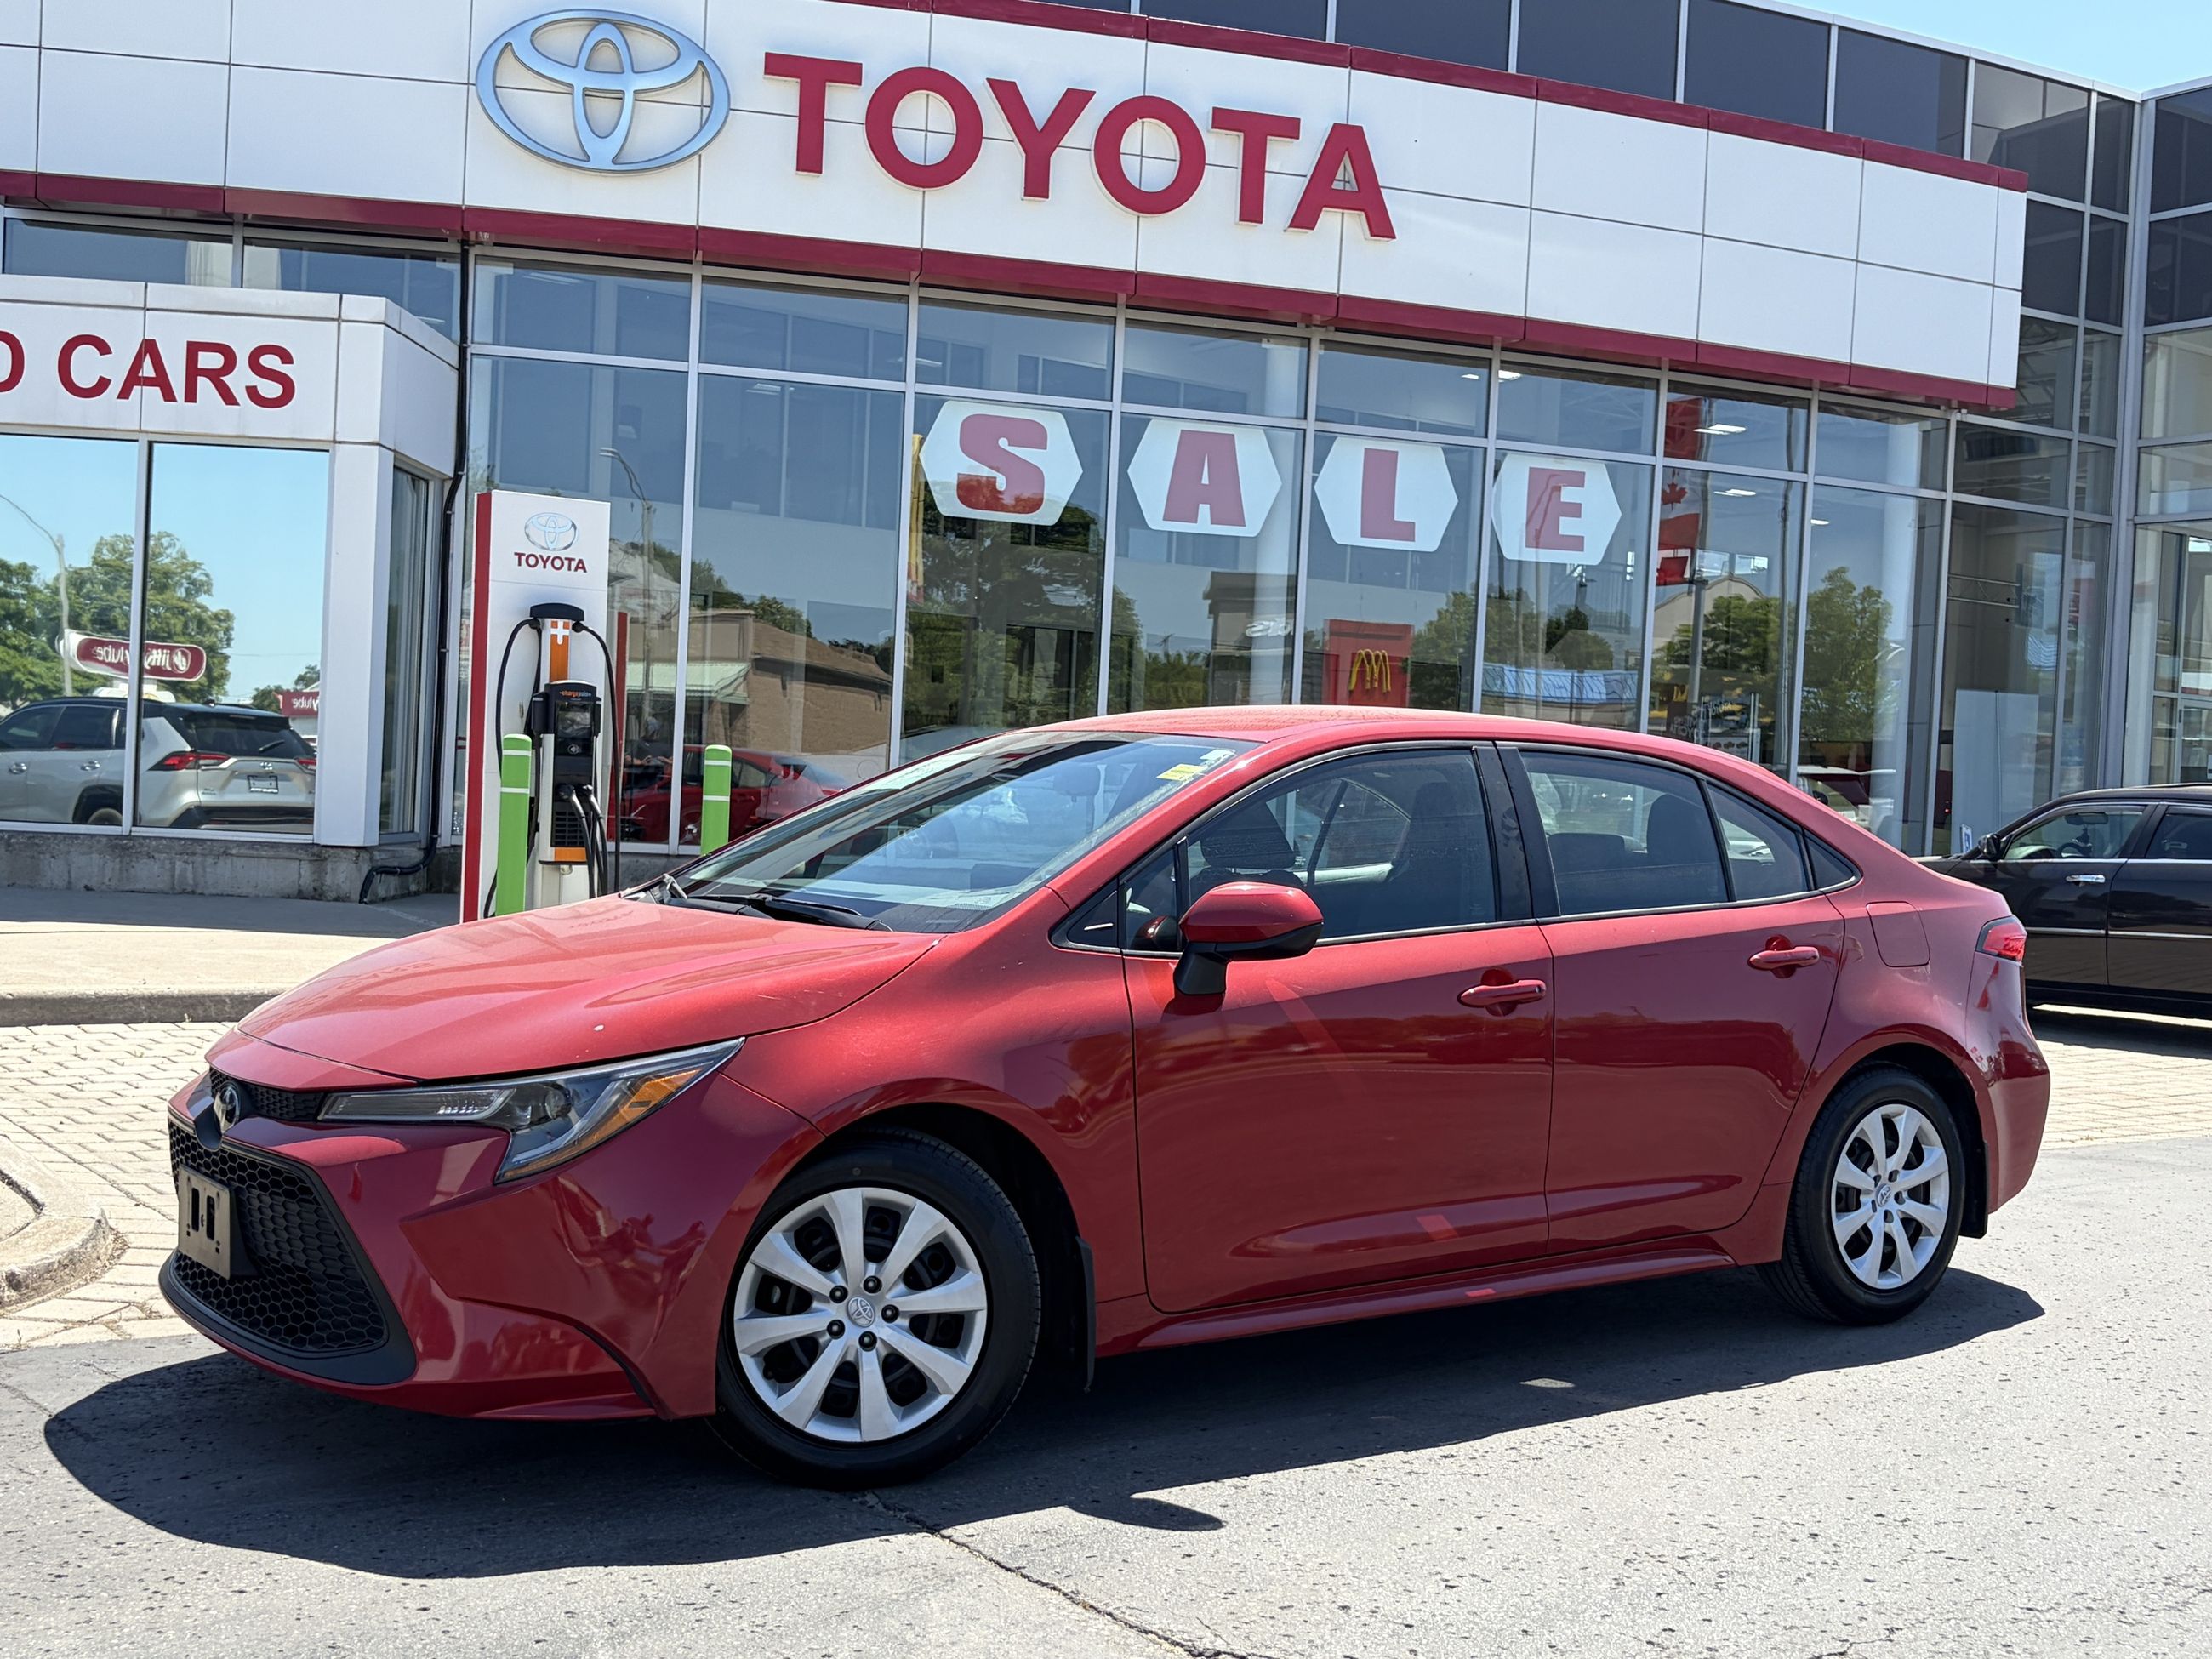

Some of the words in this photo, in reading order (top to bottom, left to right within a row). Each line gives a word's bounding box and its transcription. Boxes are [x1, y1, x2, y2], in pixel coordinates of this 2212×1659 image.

[764, 52, 1397, 241] TOYOTA
[57, 334, 296, 409] CARS
[956, 413, 1587, 552] SALE
[514, 551, 587, 573] TOYOTA
